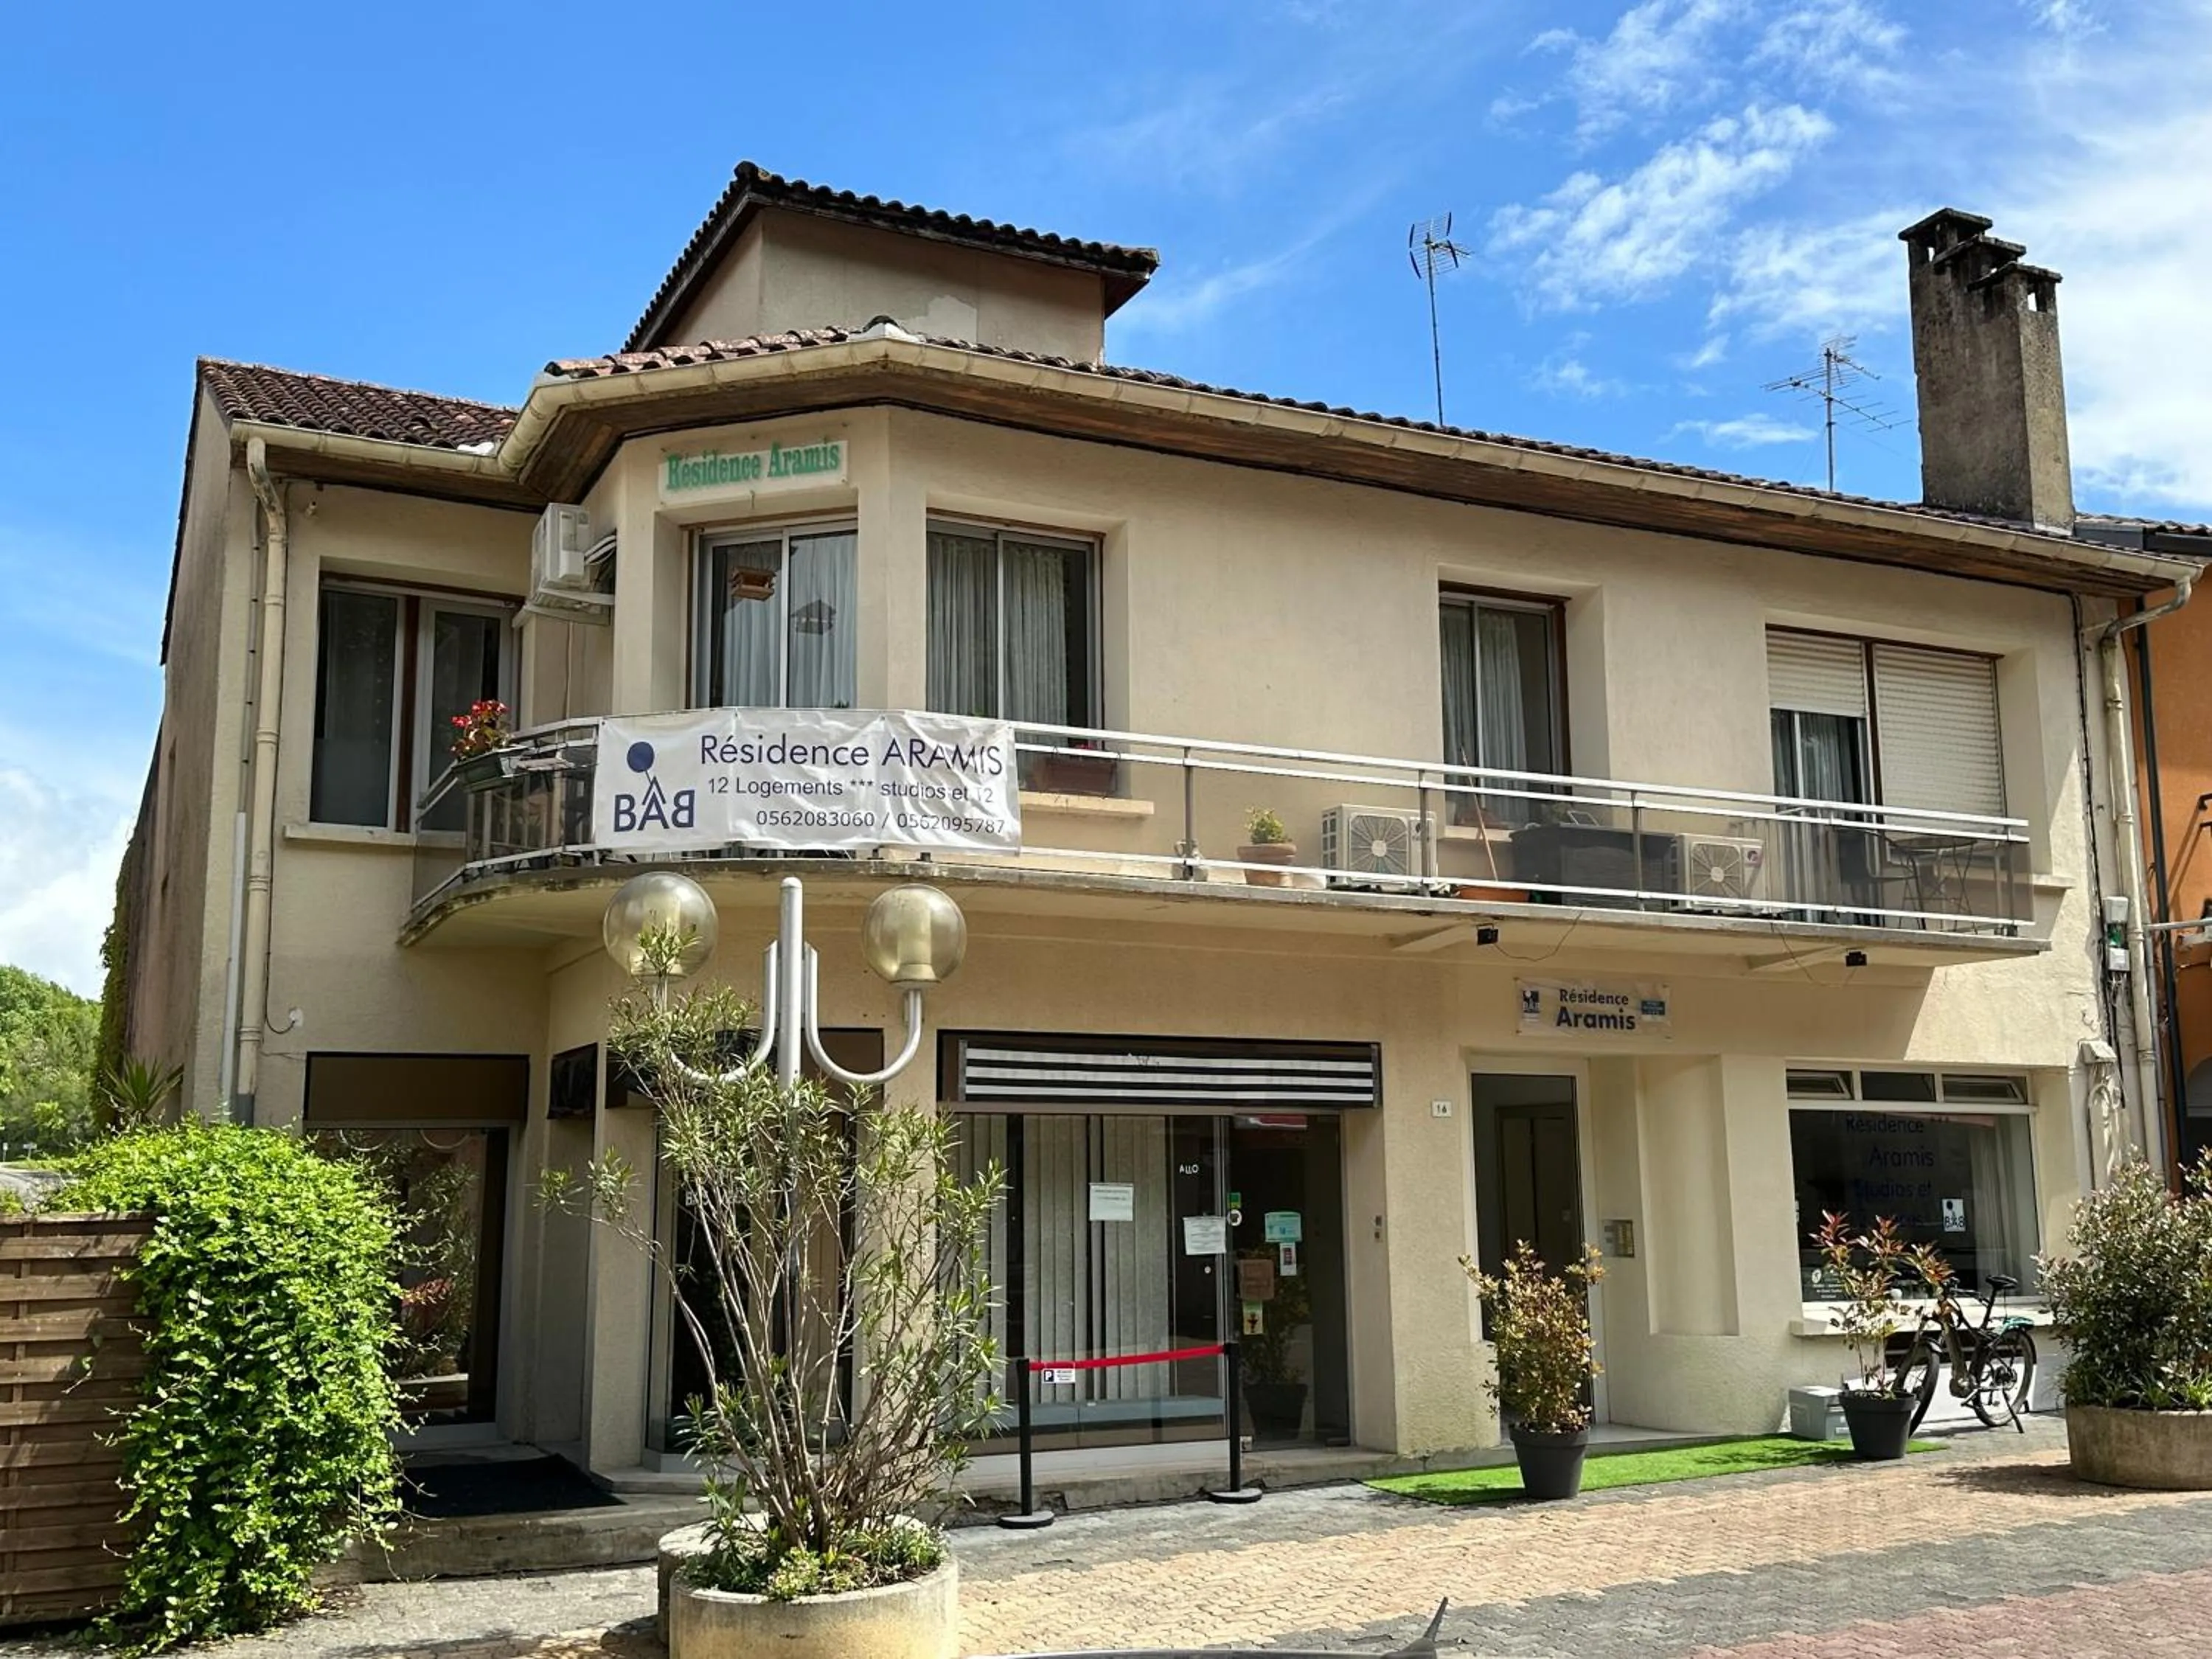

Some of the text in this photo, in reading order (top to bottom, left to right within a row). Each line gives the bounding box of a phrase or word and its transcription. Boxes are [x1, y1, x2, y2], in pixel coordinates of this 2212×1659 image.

[667, 439, 840, 490] Résidence Aramis
[701, 733, 1003, 776] Résidence ARAMIS
[709, 777, 728, 794] 12
[736, 777, 844, 799] Logements
[880, 781, 946, 800] studios
[951, 785, 969, 801] et
[757, 810, 875, 827] 0562083060
[897, 813, 1005, 834] 0562095787
[1559, 988, 1629, 1006] Résidence
[1556, 1006, 1635, 1031] Aramis
[1868, 1145, 1935, 1168] Aramis
